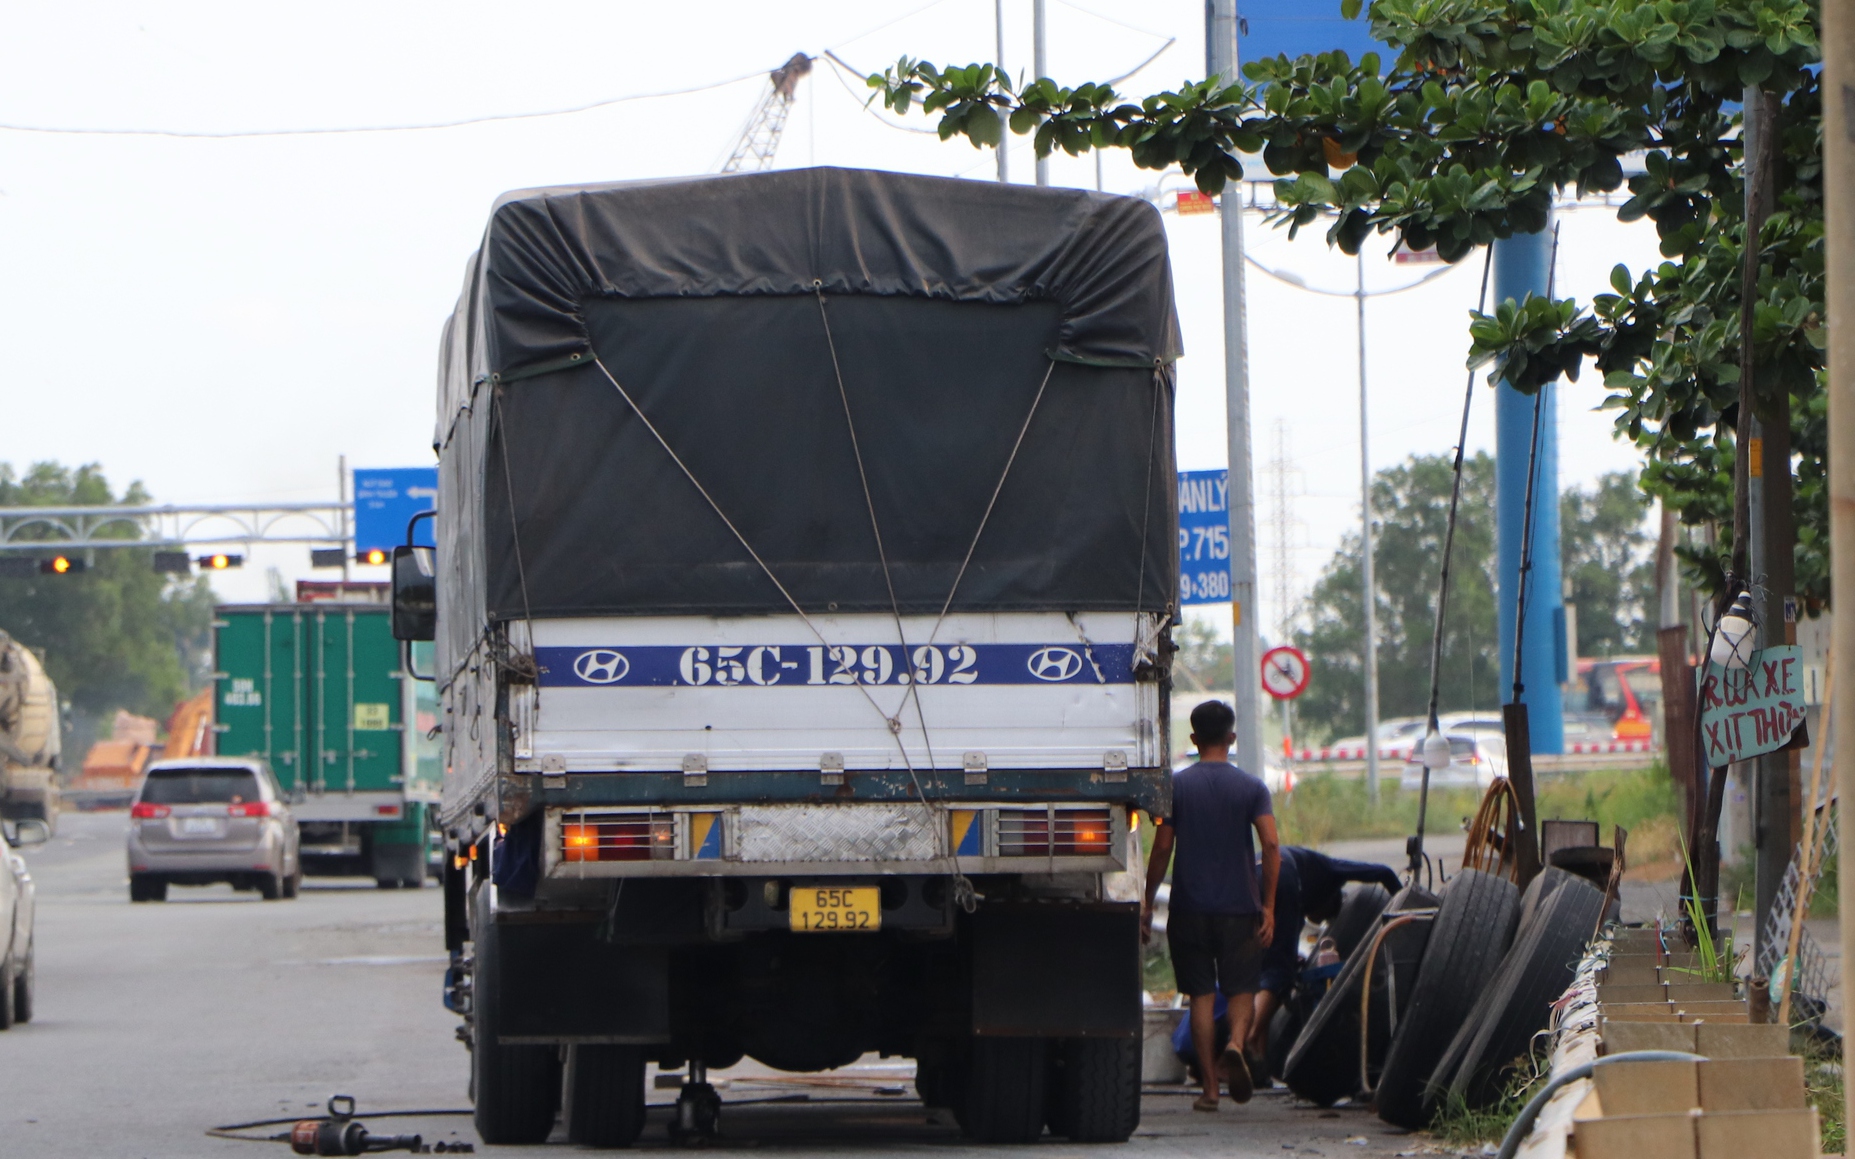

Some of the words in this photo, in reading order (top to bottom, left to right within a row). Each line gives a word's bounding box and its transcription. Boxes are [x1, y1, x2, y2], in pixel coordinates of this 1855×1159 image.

[680, 646, 978, 686] 65C-129.92
[1762, 658, 1796, 698] XE
[816, 890, 853, 908] 65C
[802, 911, 870, 930] 129.92
